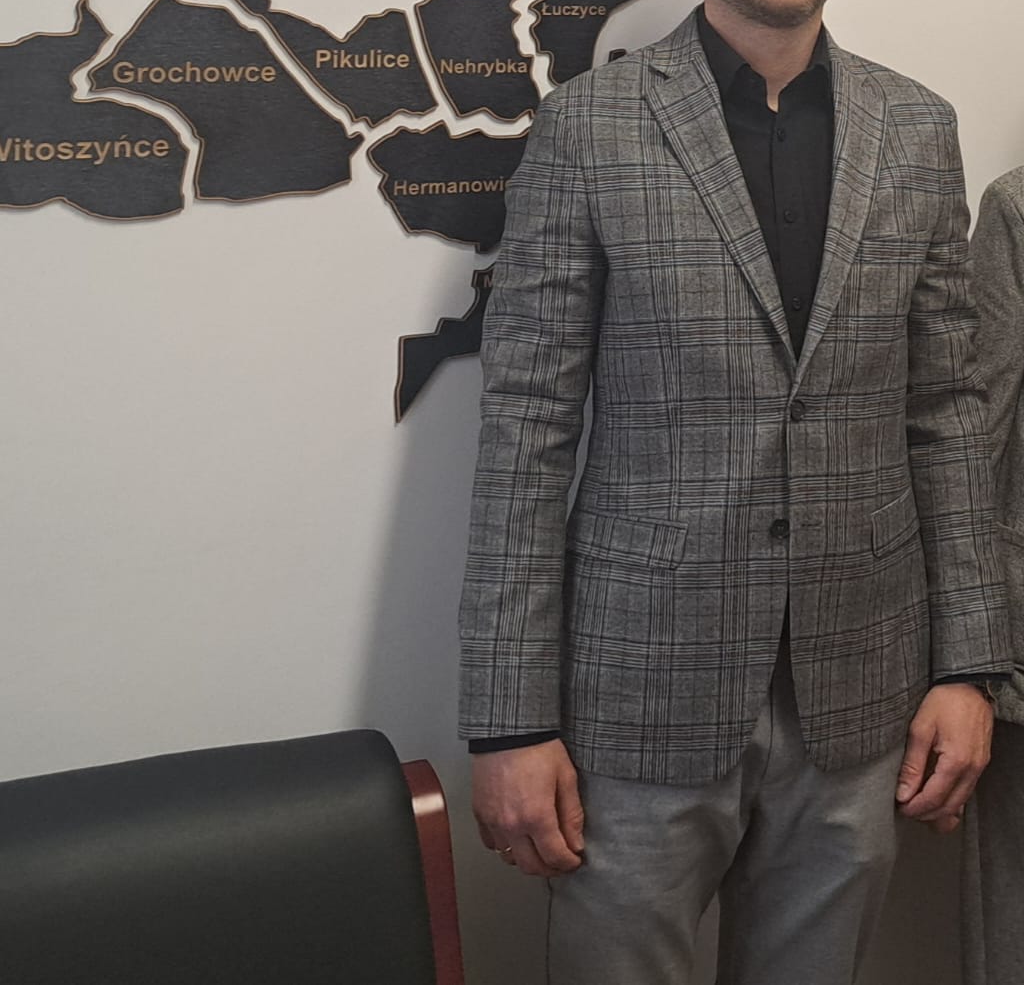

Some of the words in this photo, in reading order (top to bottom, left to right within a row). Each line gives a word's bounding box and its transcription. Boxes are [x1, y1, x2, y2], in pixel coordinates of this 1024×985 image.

[541, 2, 607, 19] Łuczyce
[315, 49, 410, 69] Pikulice
[440, 59, 529, 77] Nehrybka
[112, 61, 277, 83] Grochowce
